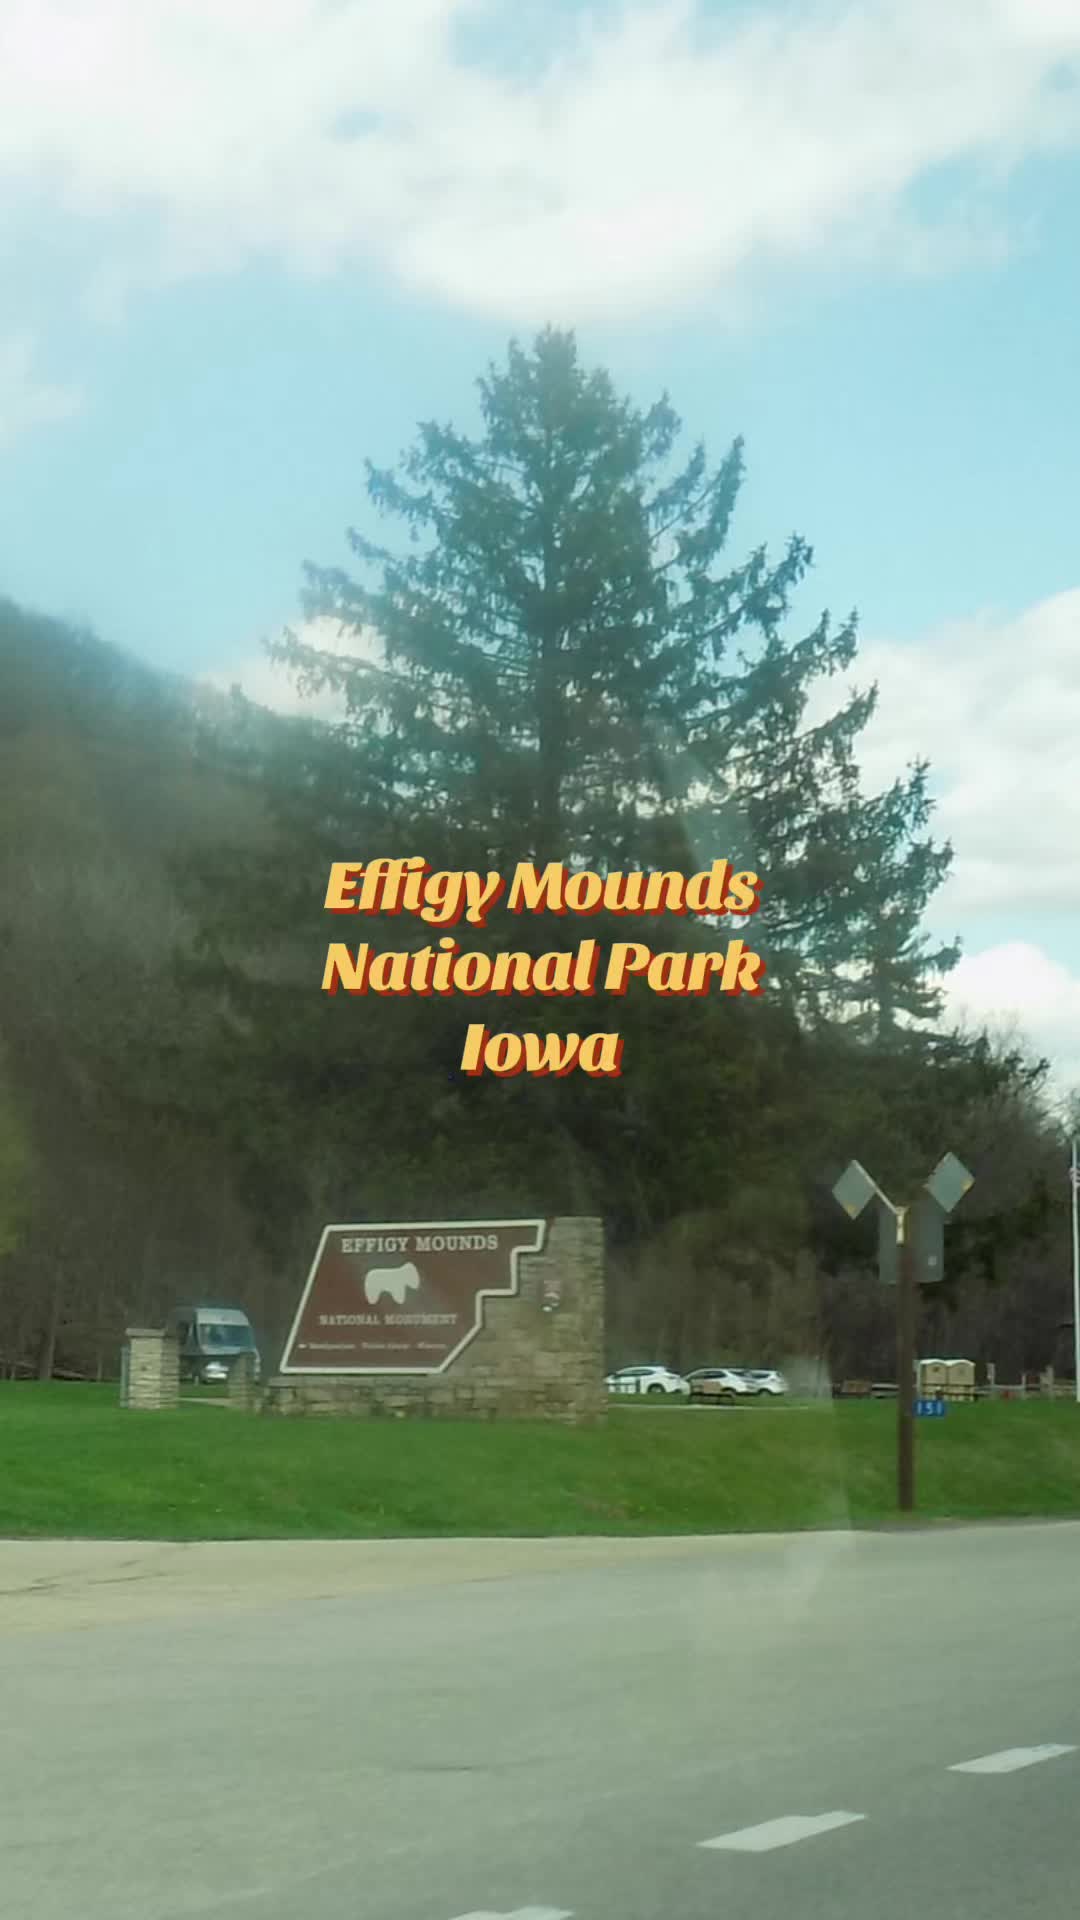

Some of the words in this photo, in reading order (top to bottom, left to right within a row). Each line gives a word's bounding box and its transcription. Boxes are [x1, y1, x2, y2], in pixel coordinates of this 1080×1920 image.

[341, 1236, 410, 1254] EFFIGY
[415, 1234, 499, 1252] MOUNDS
[319, 1314, 380, 1326] NATIONAL
[383, 1313, 458, 1326] MONUMENT
